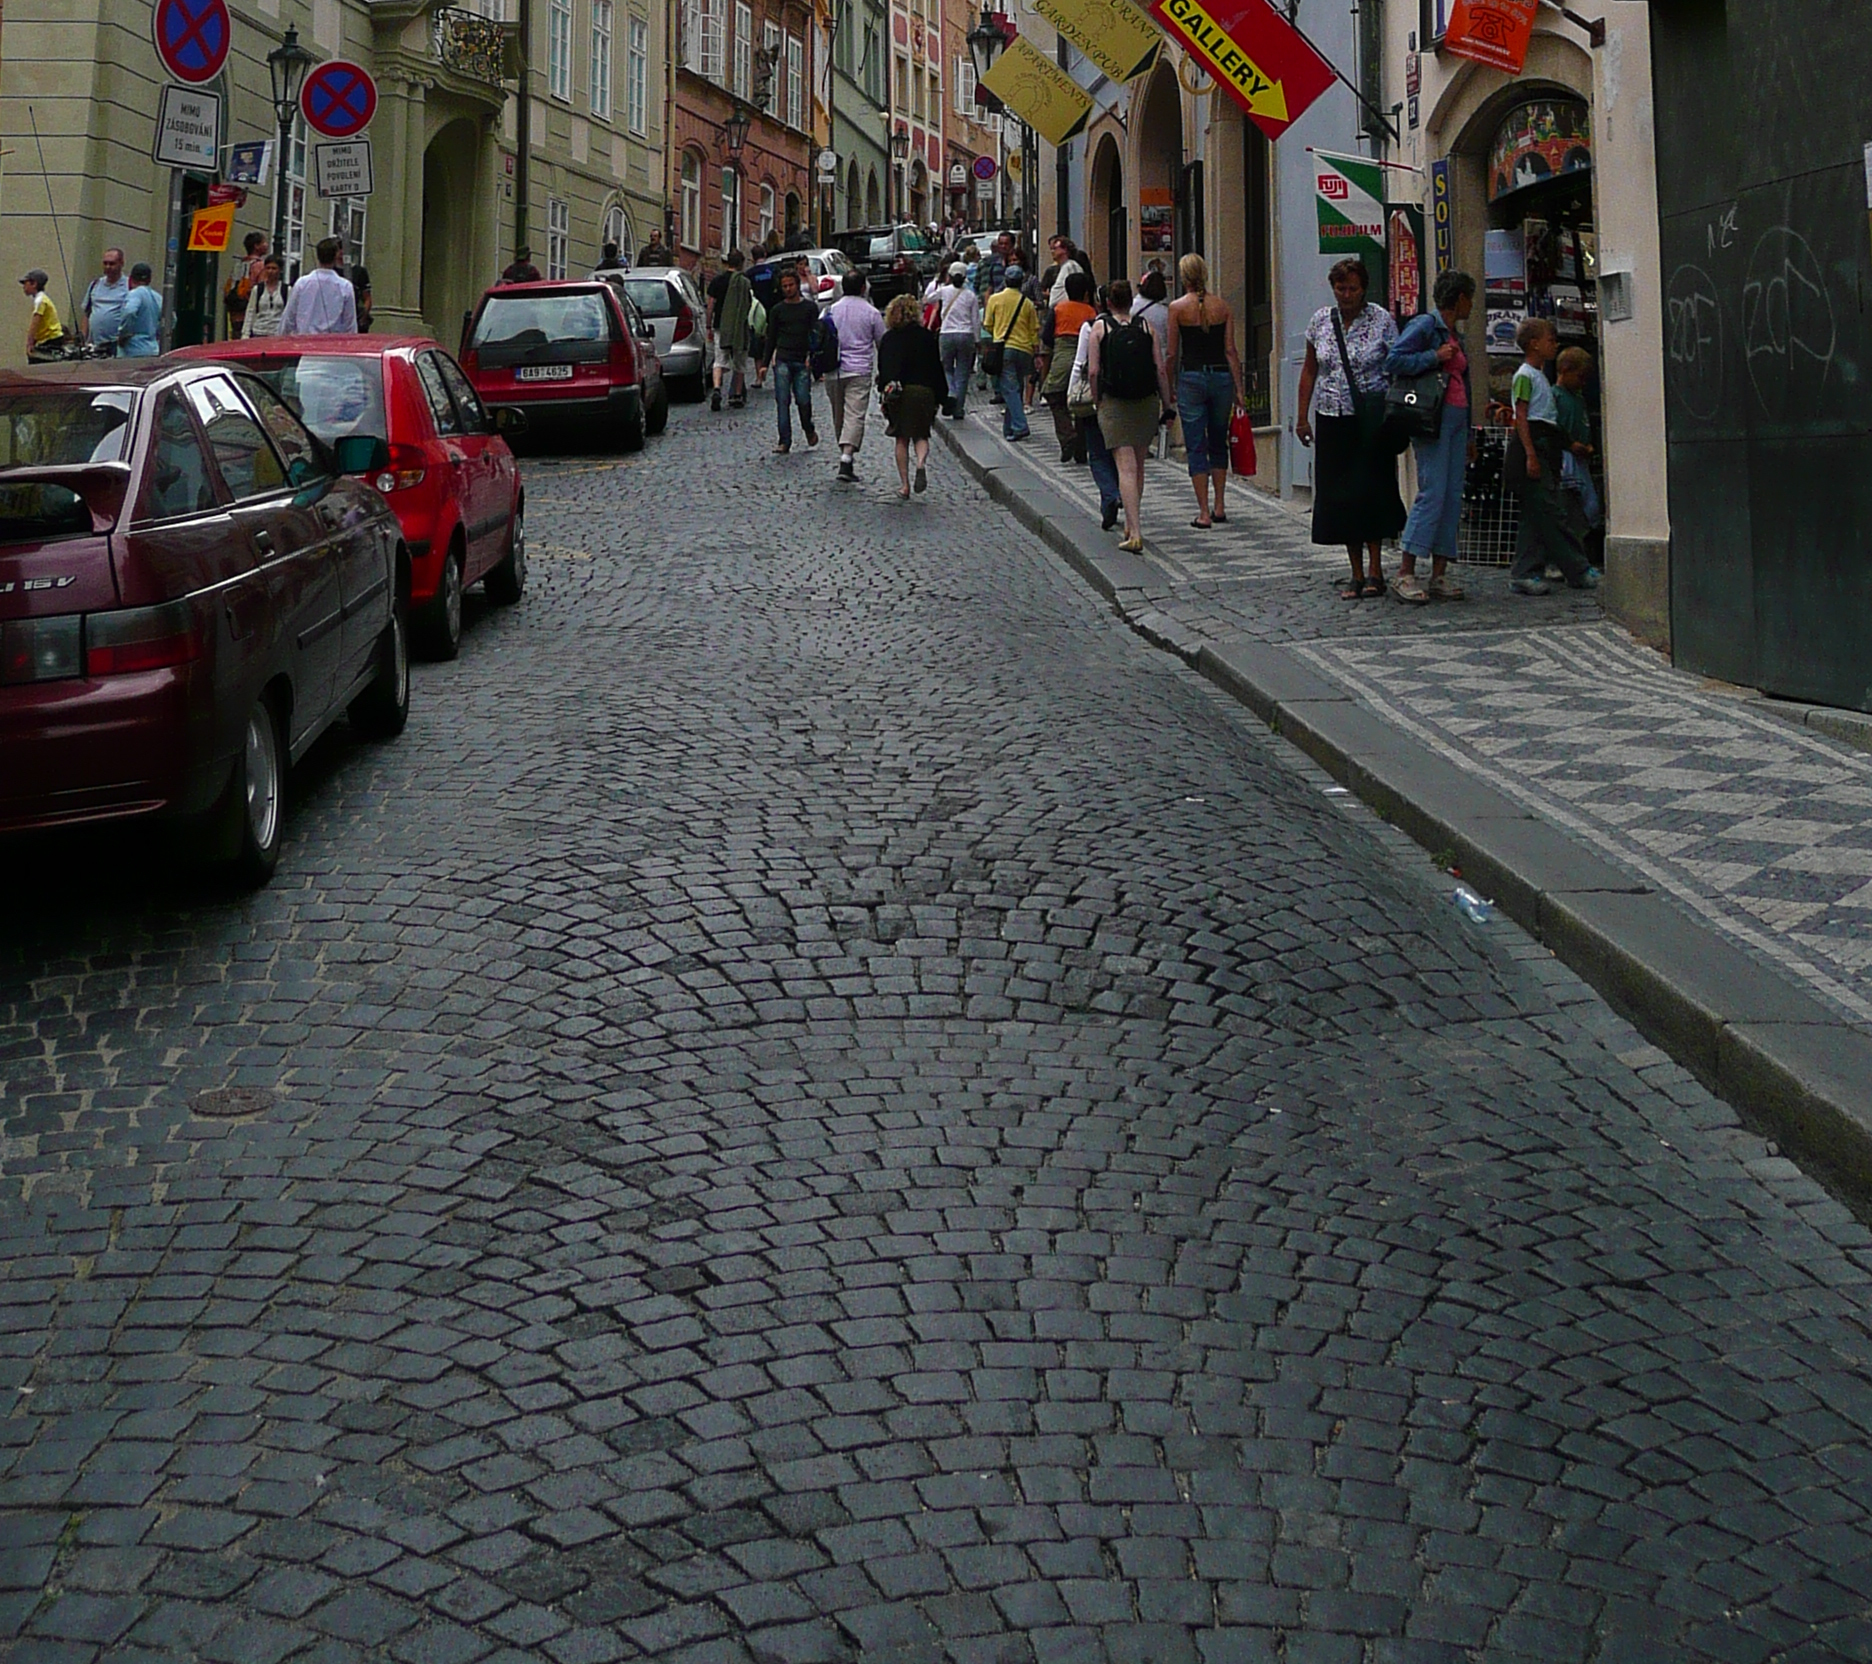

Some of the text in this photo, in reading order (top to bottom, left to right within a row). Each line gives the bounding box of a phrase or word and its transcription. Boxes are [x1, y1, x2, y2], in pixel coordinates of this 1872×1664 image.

[1092, 50, 1125, 79] PUB
[1012, 41, 1093, 109] APARTMENTS
[180, 102, 201, 118] MIMO
[174, 137, 184, 151] 15
[1320, 224, 1382, 237] FUJIFILM
